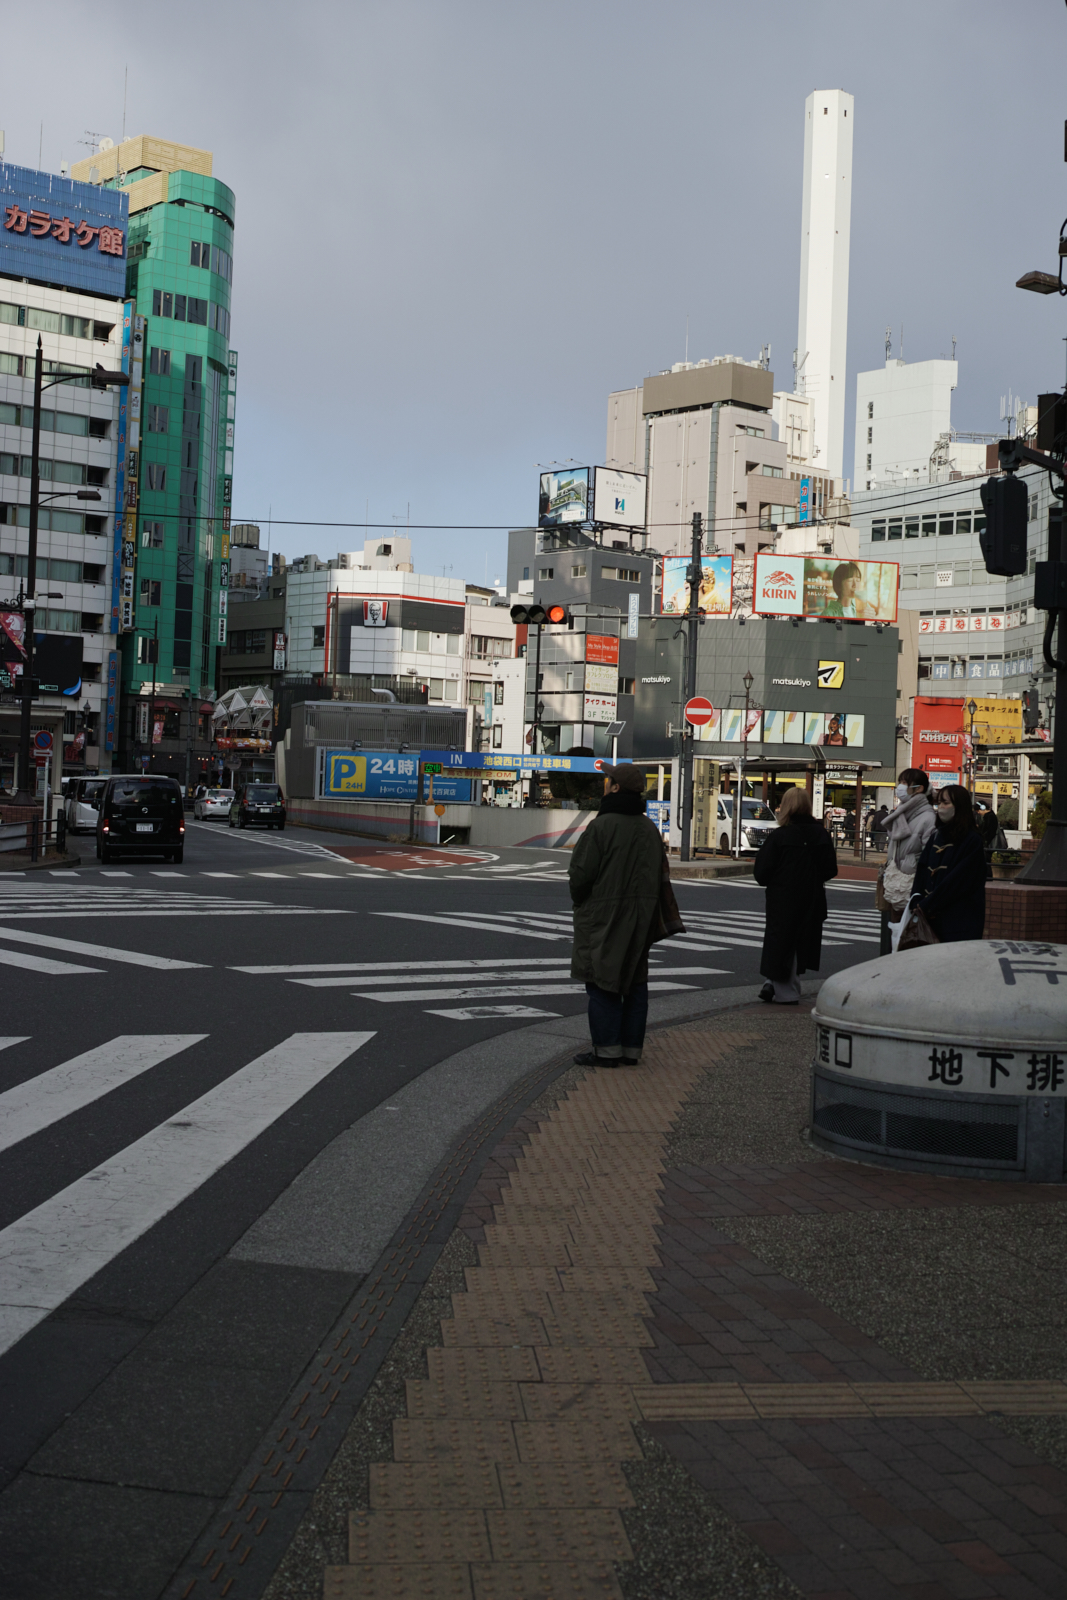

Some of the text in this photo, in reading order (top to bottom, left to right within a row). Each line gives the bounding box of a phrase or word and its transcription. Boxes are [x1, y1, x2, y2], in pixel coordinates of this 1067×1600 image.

[4, 204, 123, 256] カラオケ館
[762, 588, 796, 600] KIRIN
[642, 676, 670, 684] matsukiyo
[772, 678, 811, 687] matsukiyo
[108, 659, 116, 742] カラオケ館
[450, 754, 462, 764] IN
[483, 756, 522, 767] 池袋西口
[542, 758, 571, 769] 駐車場
[333, 758, 356, 788] P
[424, 763, 441, 773] 空車
[928, 1047, 1064, 1092] 地下排
